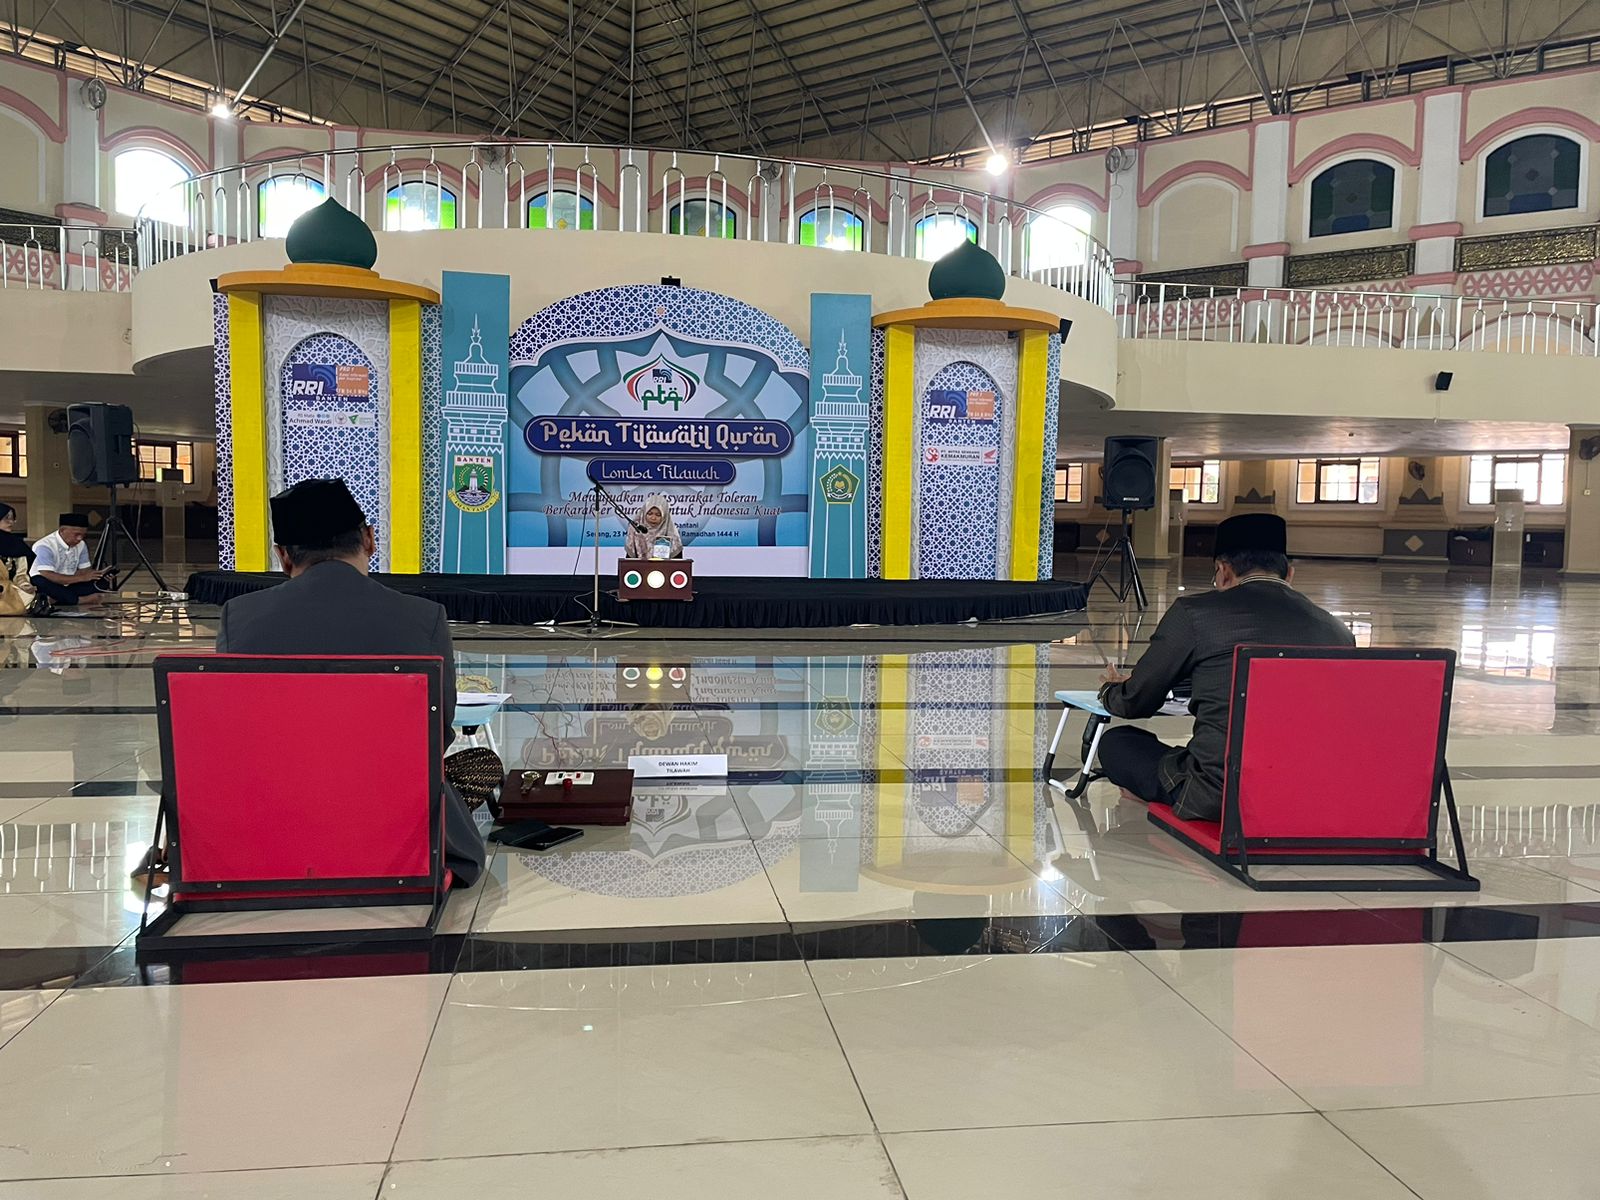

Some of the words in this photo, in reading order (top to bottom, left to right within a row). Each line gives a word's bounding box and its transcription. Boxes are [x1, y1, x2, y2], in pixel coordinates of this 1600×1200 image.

[292, 380, 324, 396] RRI
[929, 405, 957, 419] RRI
[602, 461, 653, 480] Lomba
[657, 463, 720, 480] Tilawah
[717, 491, 758, 503] Toleran
[543, 502, 613, 518] Berkaraker
[669, 504, 697, 518] ntuk
[697, 504, 750, 516] Indonesia
[752, 505, 782, 516] Kuat
